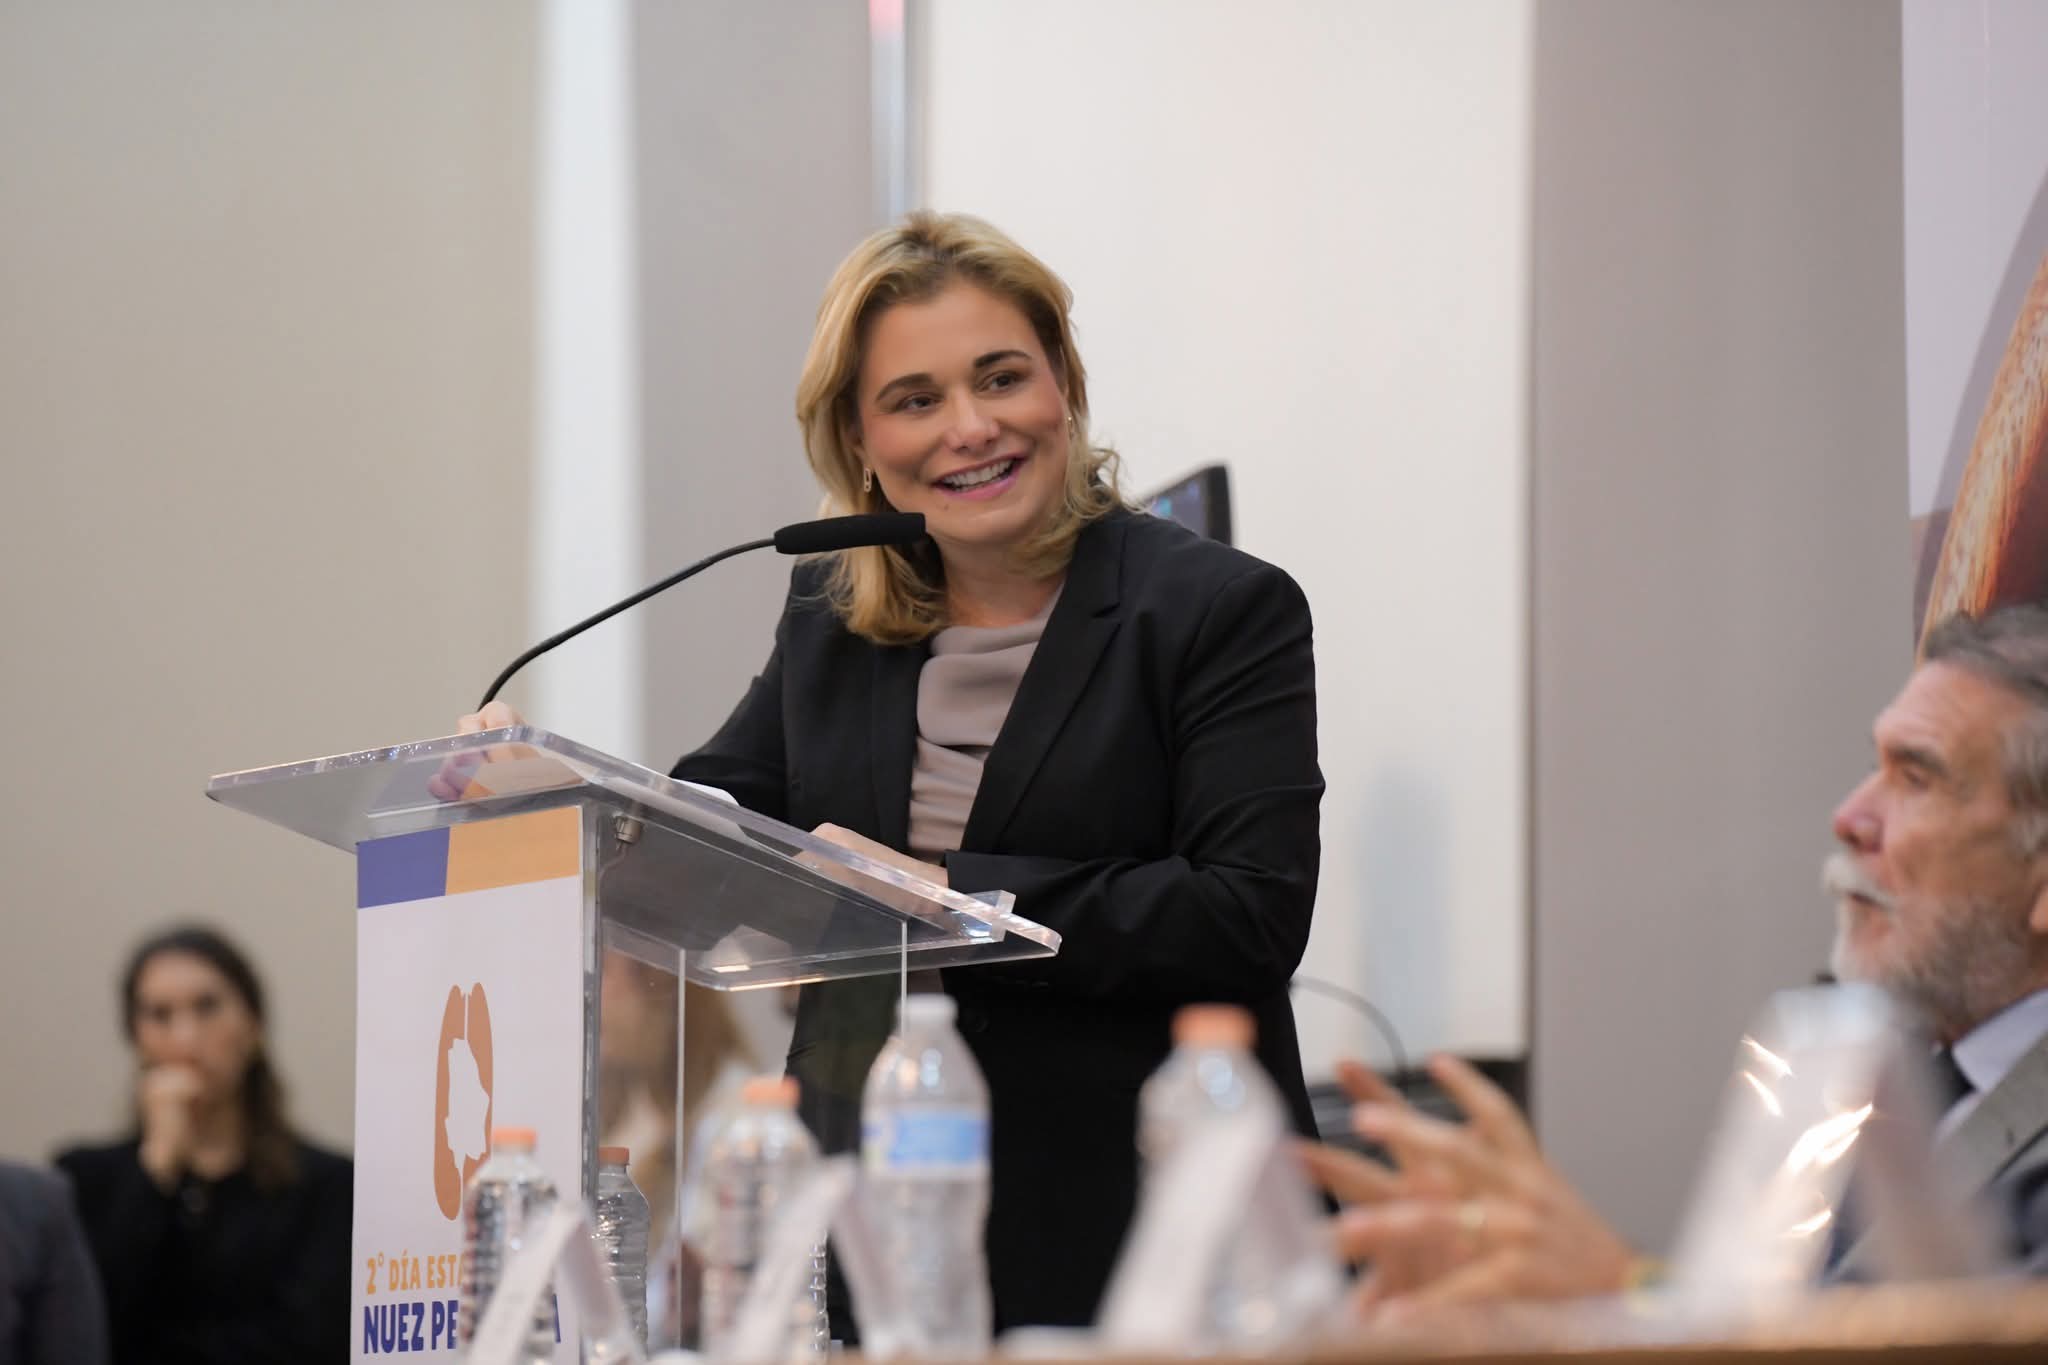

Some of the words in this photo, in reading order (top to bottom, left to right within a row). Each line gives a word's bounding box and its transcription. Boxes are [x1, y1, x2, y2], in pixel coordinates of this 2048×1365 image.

[389, 1250, 421, 1291] DÍA
[427, 1253, 465, 1289] ESTA
[363, 1302, 424, 1354] NUEZ
